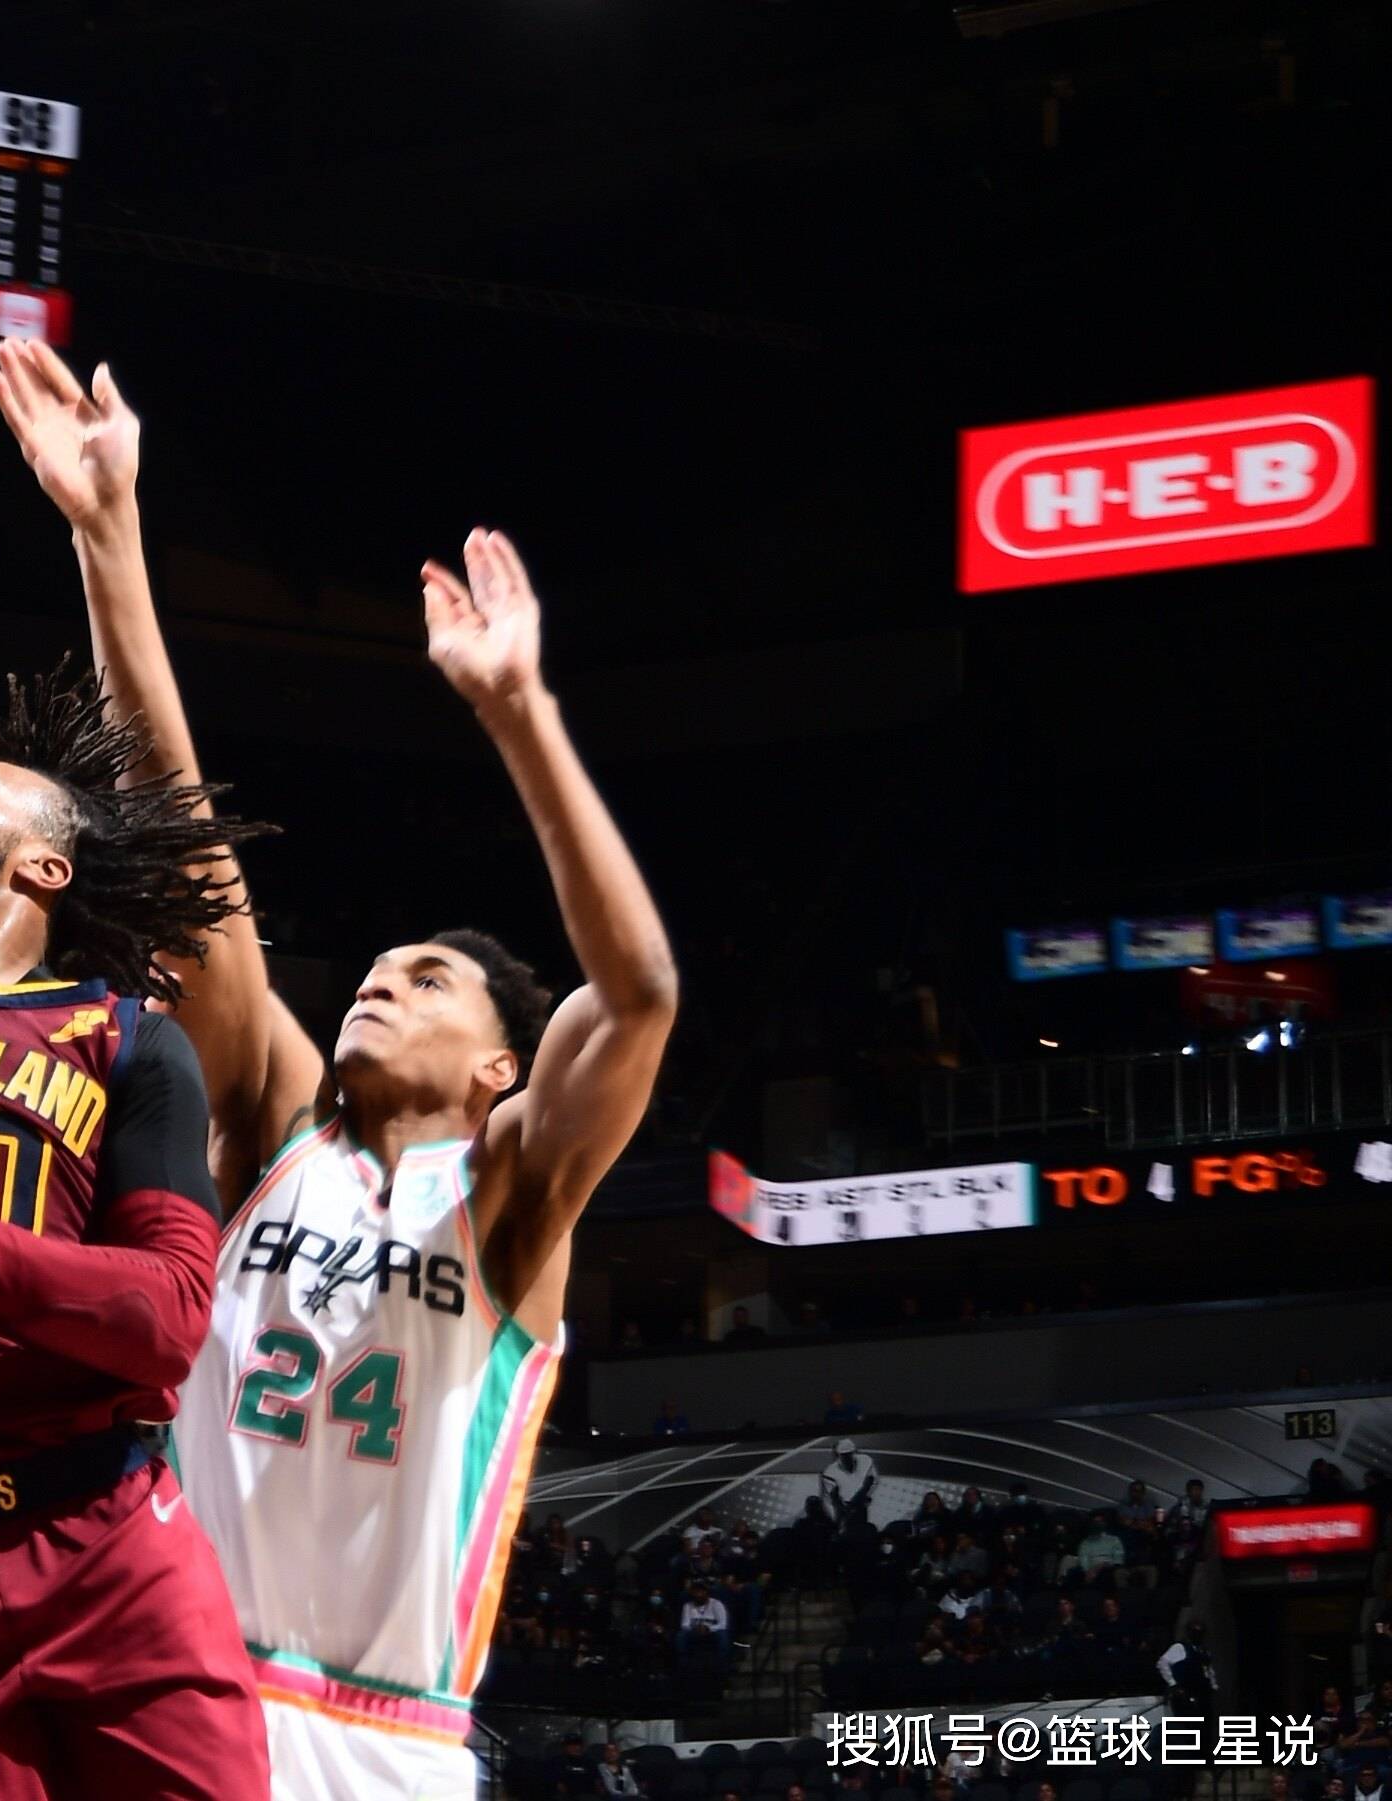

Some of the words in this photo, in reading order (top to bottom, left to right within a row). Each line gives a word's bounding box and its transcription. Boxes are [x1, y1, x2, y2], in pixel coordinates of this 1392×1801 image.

[1042, 1167, 1128, 1208] TO
[239, 1220, 466, 1319] SPURS
[226, 1323, 408, 1468] 24
[1286, 1411, 1334, 1438] 113
